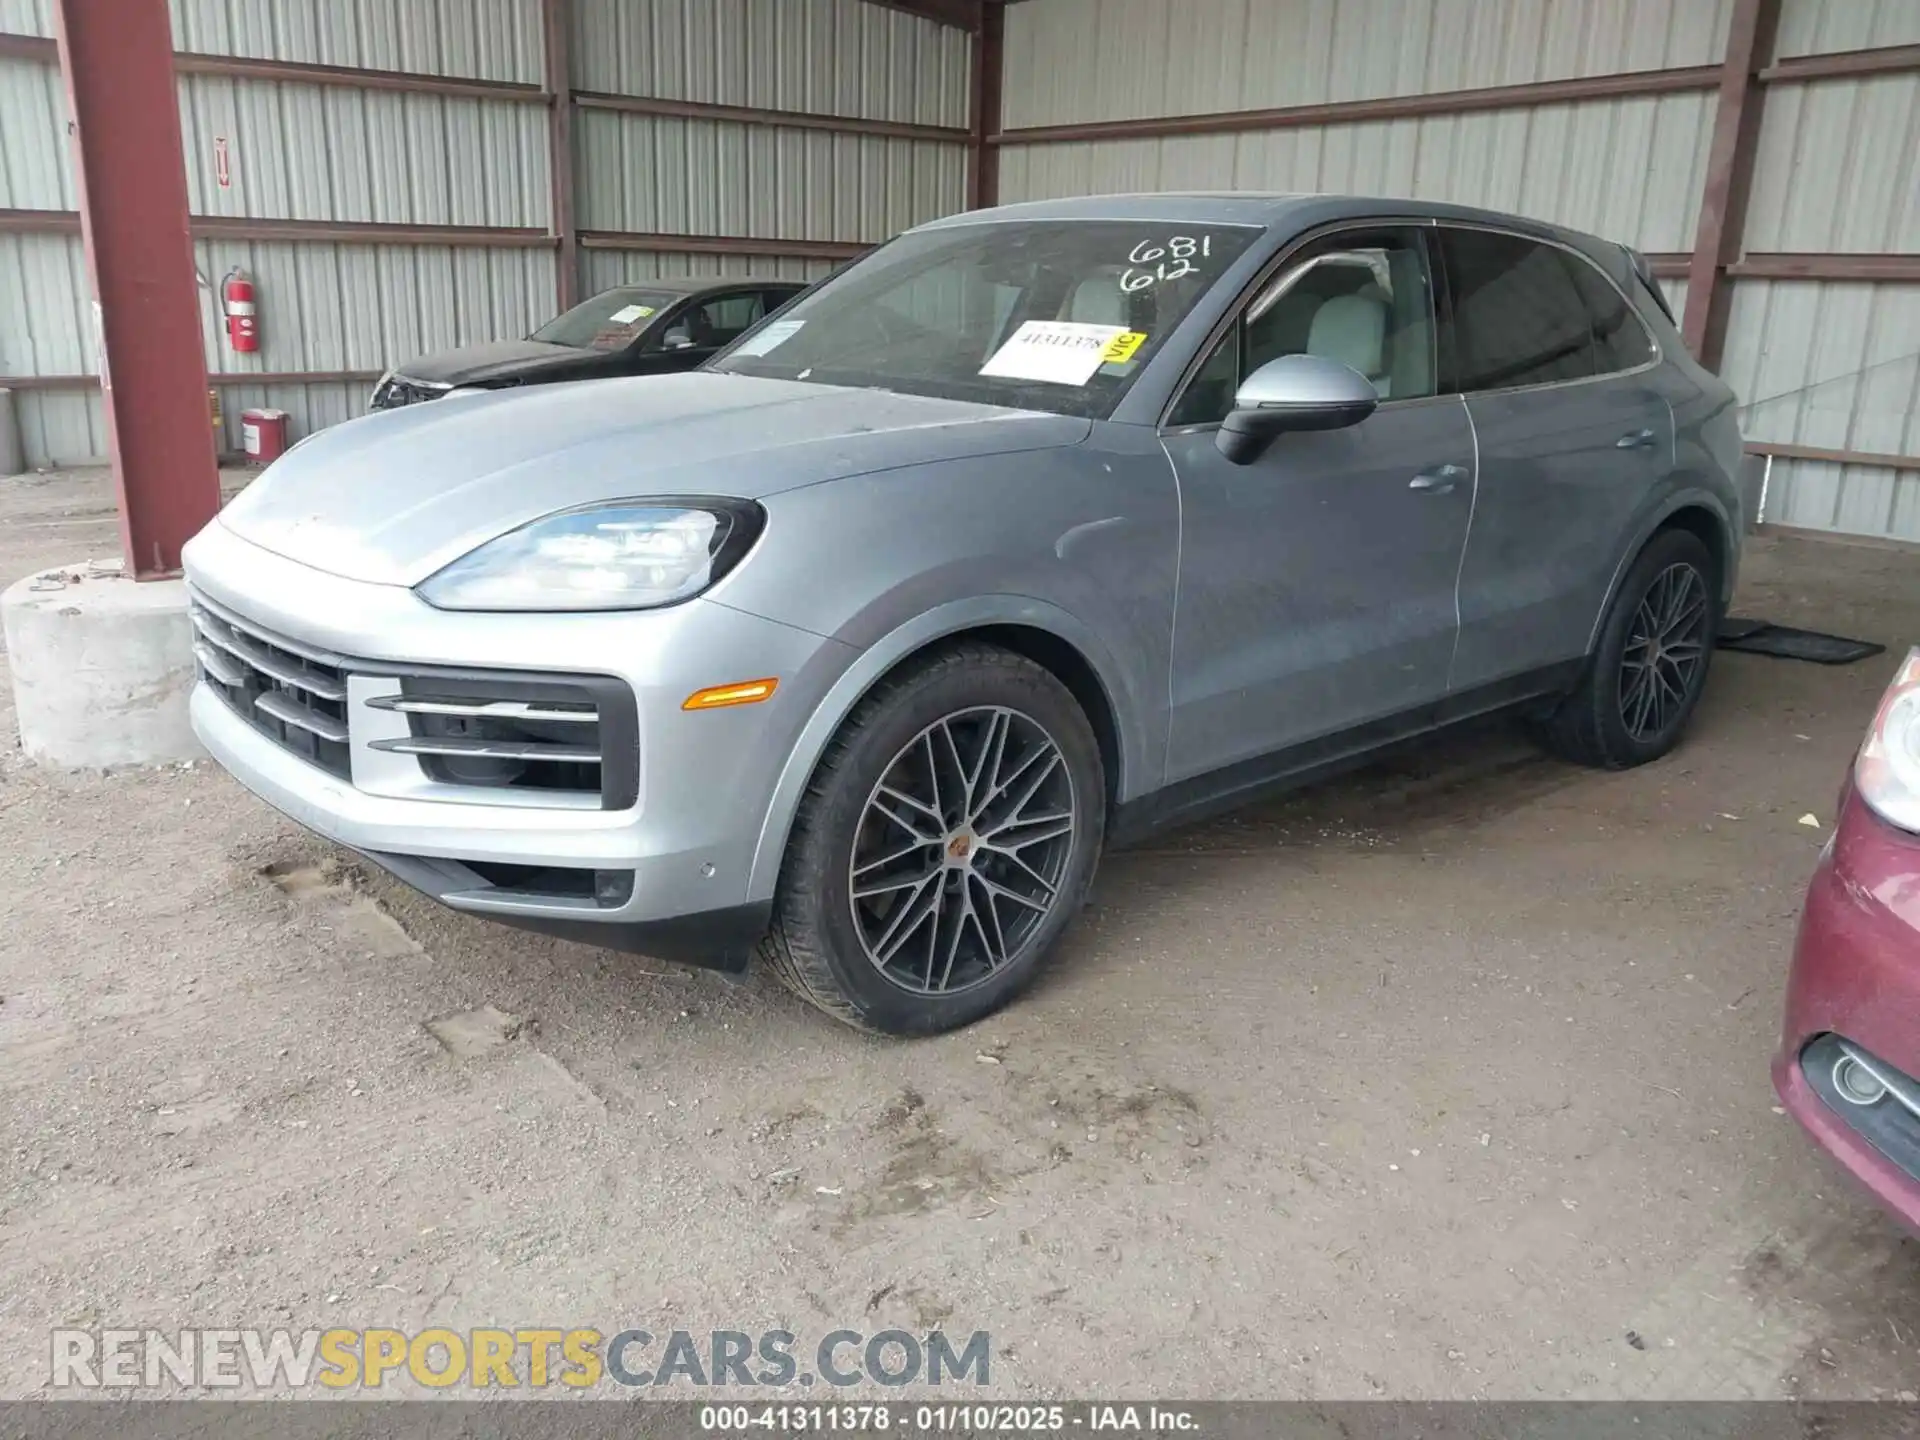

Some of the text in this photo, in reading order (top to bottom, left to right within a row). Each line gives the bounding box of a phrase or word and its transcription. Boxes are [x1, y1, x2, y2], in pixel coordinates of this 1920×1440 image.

[1128, 235, 1211, 263] 681
[1120, 258, 1200, 292] 612
[1104, 335, 1136, 358] VIC
